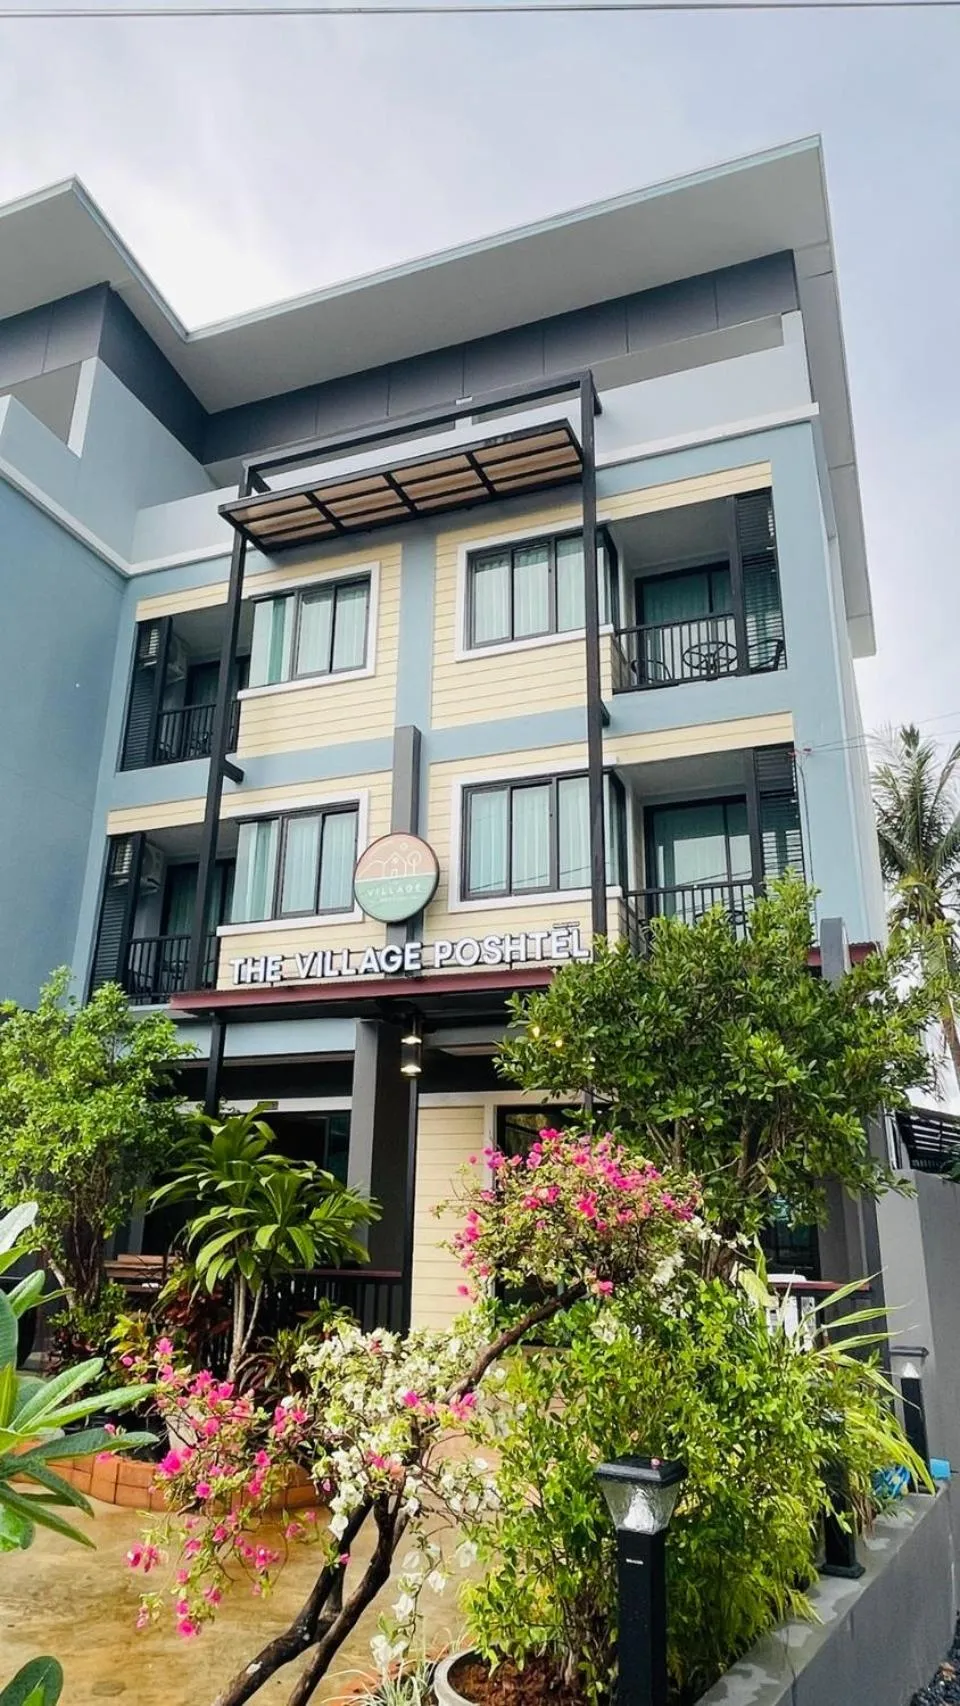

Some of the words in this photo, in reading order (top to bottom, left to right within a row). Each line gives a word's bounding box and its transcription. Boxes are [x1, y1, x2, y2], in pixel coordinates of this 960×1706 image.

[366, 883, 422, 897] VILLAGE
[230, 954, 283, 985] THE
[295, 941, 423, 979] VILLAGE
